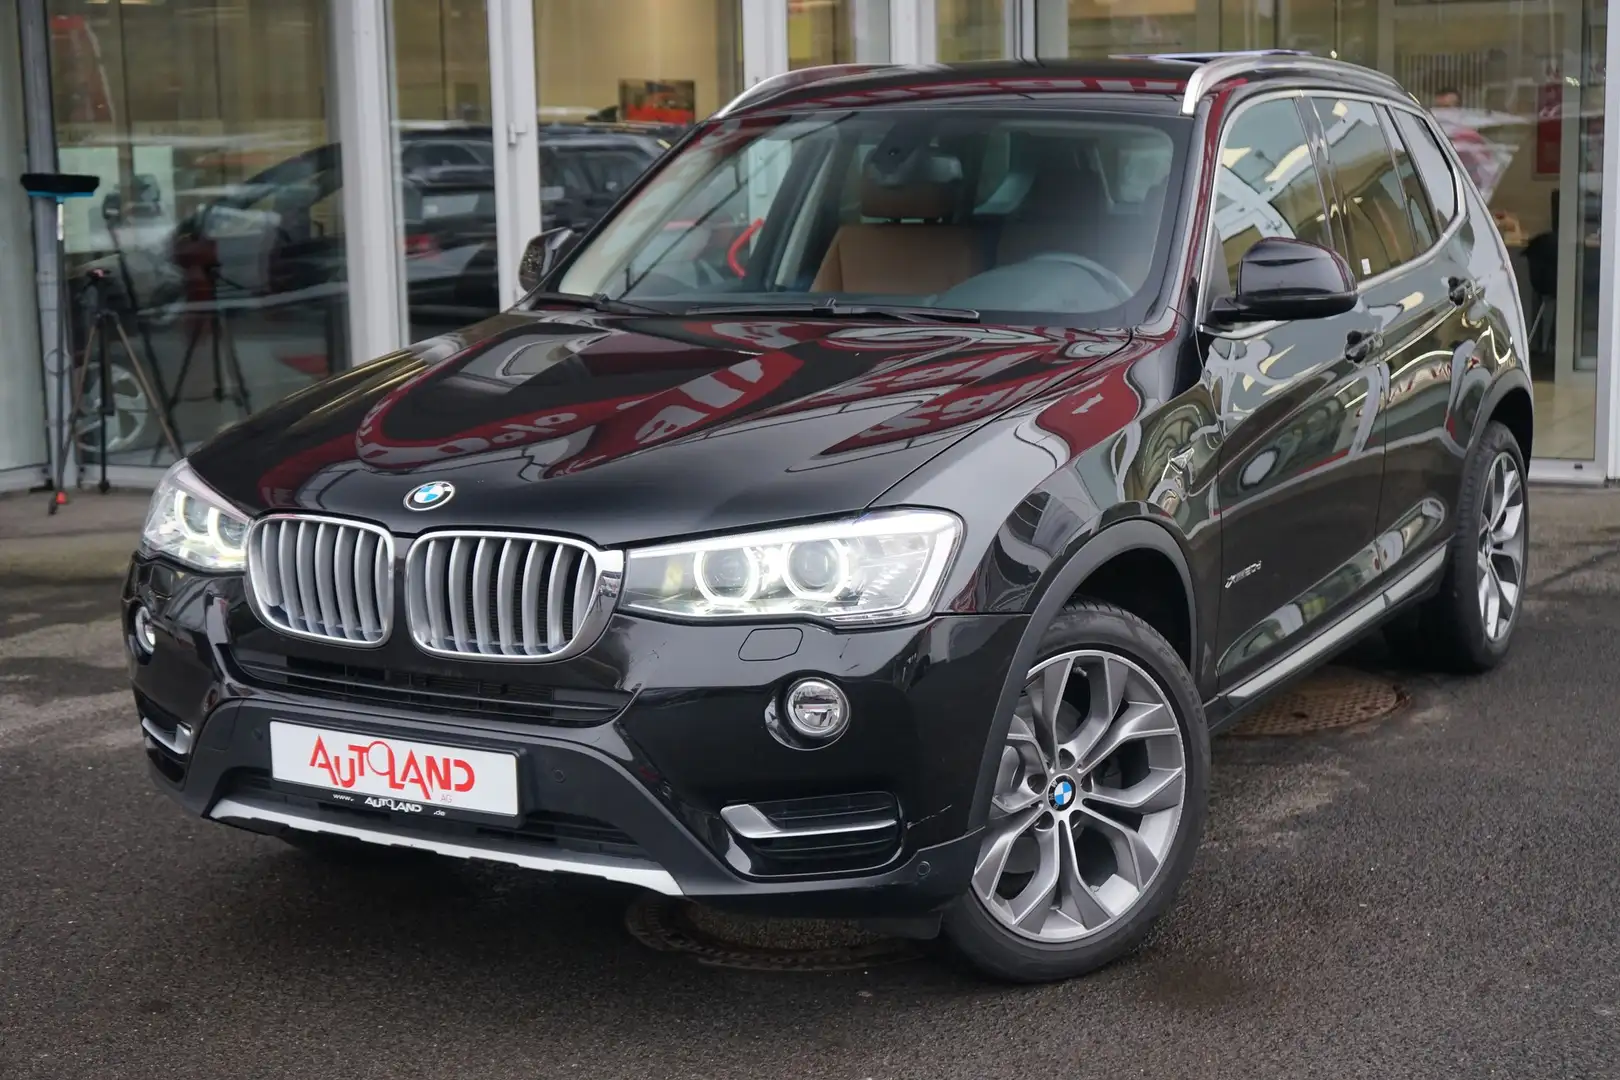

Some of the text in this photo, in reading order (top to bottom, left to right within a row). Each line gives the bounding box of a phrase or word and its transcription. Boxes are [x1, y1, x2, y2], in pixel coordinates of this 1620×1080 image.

[309, 734, 475, 800] AUTOLAND
[364, 797, 423, 812] AUTOLAND
[433, 809, 446, 817] .de
